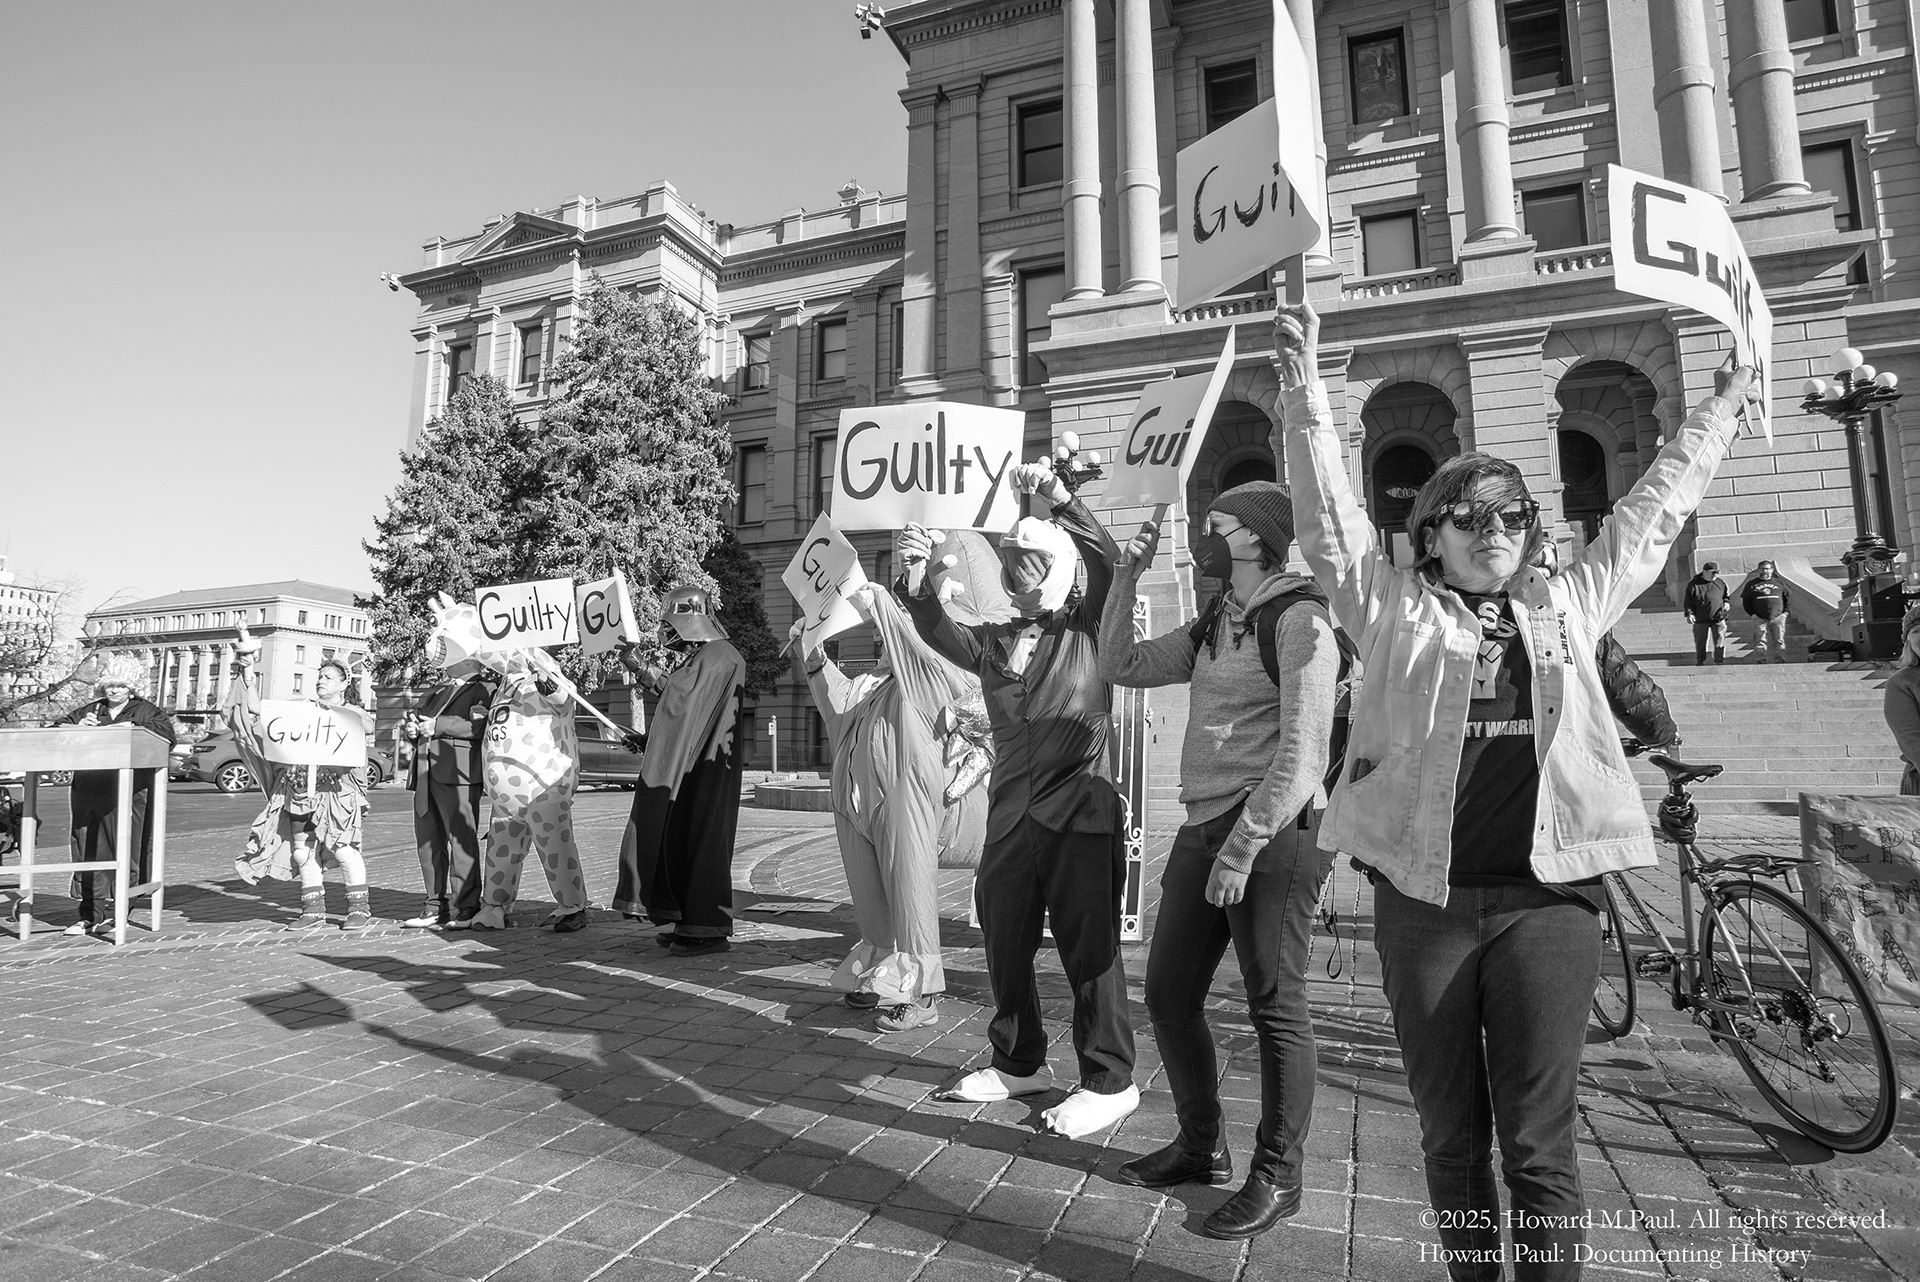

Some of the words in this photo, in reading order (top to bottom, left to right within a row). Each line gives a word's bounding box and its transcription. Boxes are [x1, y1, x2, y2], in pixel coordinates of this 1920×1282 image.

[1125, 405, 1195, 469] Gui
[841, 411, 1013, 528] Guilty
[478, 585, 572, 642] Guilty
[266, 715, 349, 756] Guilty
